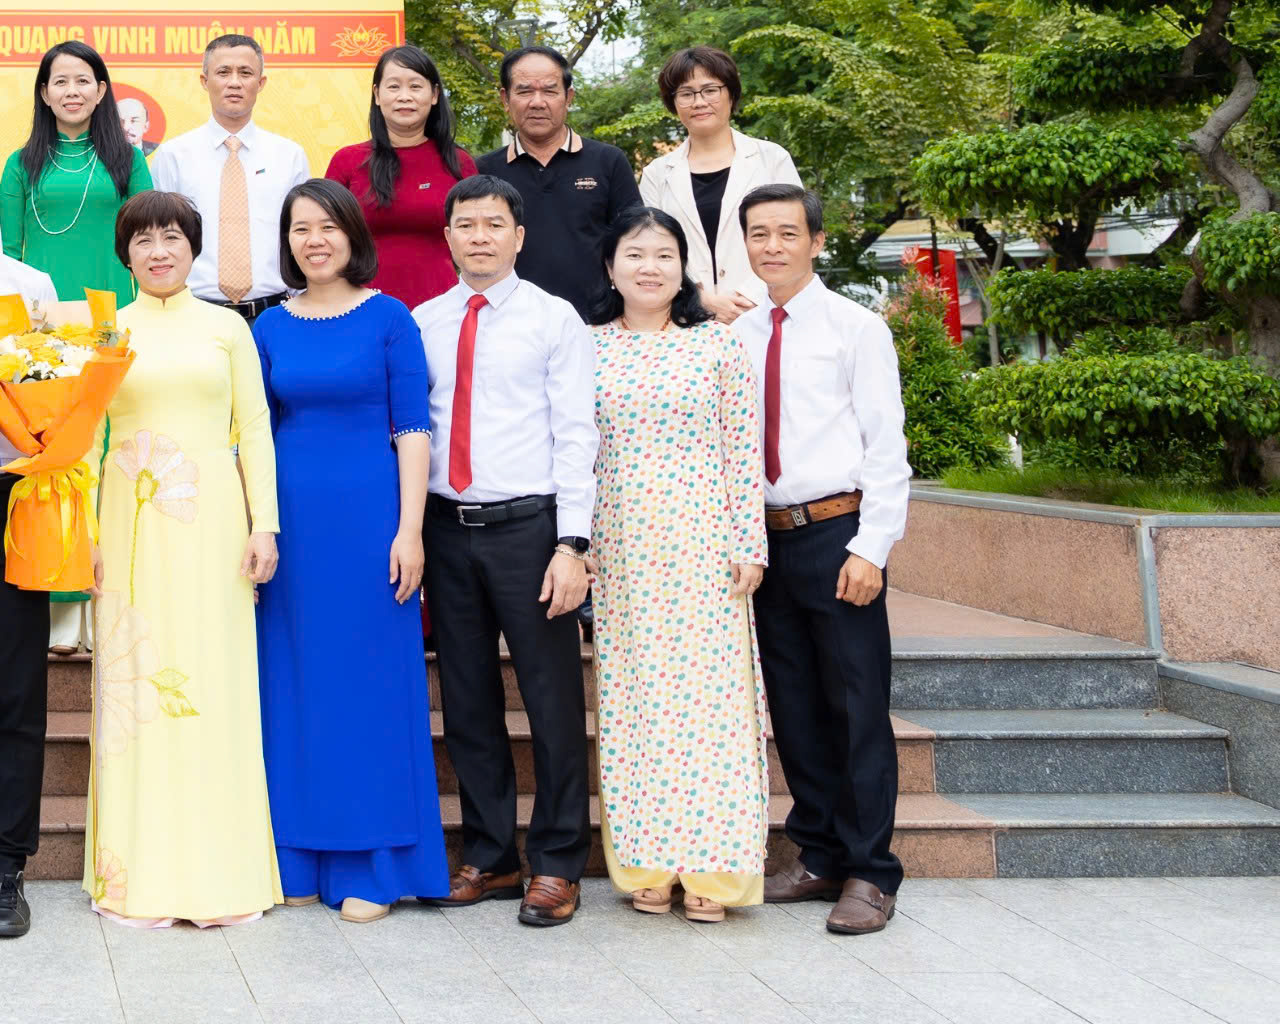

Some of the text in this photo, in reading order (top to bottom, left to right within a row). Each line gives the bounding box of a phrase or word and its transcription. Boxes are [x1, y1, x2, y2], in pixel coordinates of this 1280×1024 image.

[93, 26, 156, 54] VINH
[163, 20, 245, 54] MUÔ
[253, 20, 316, 54] NĂM
